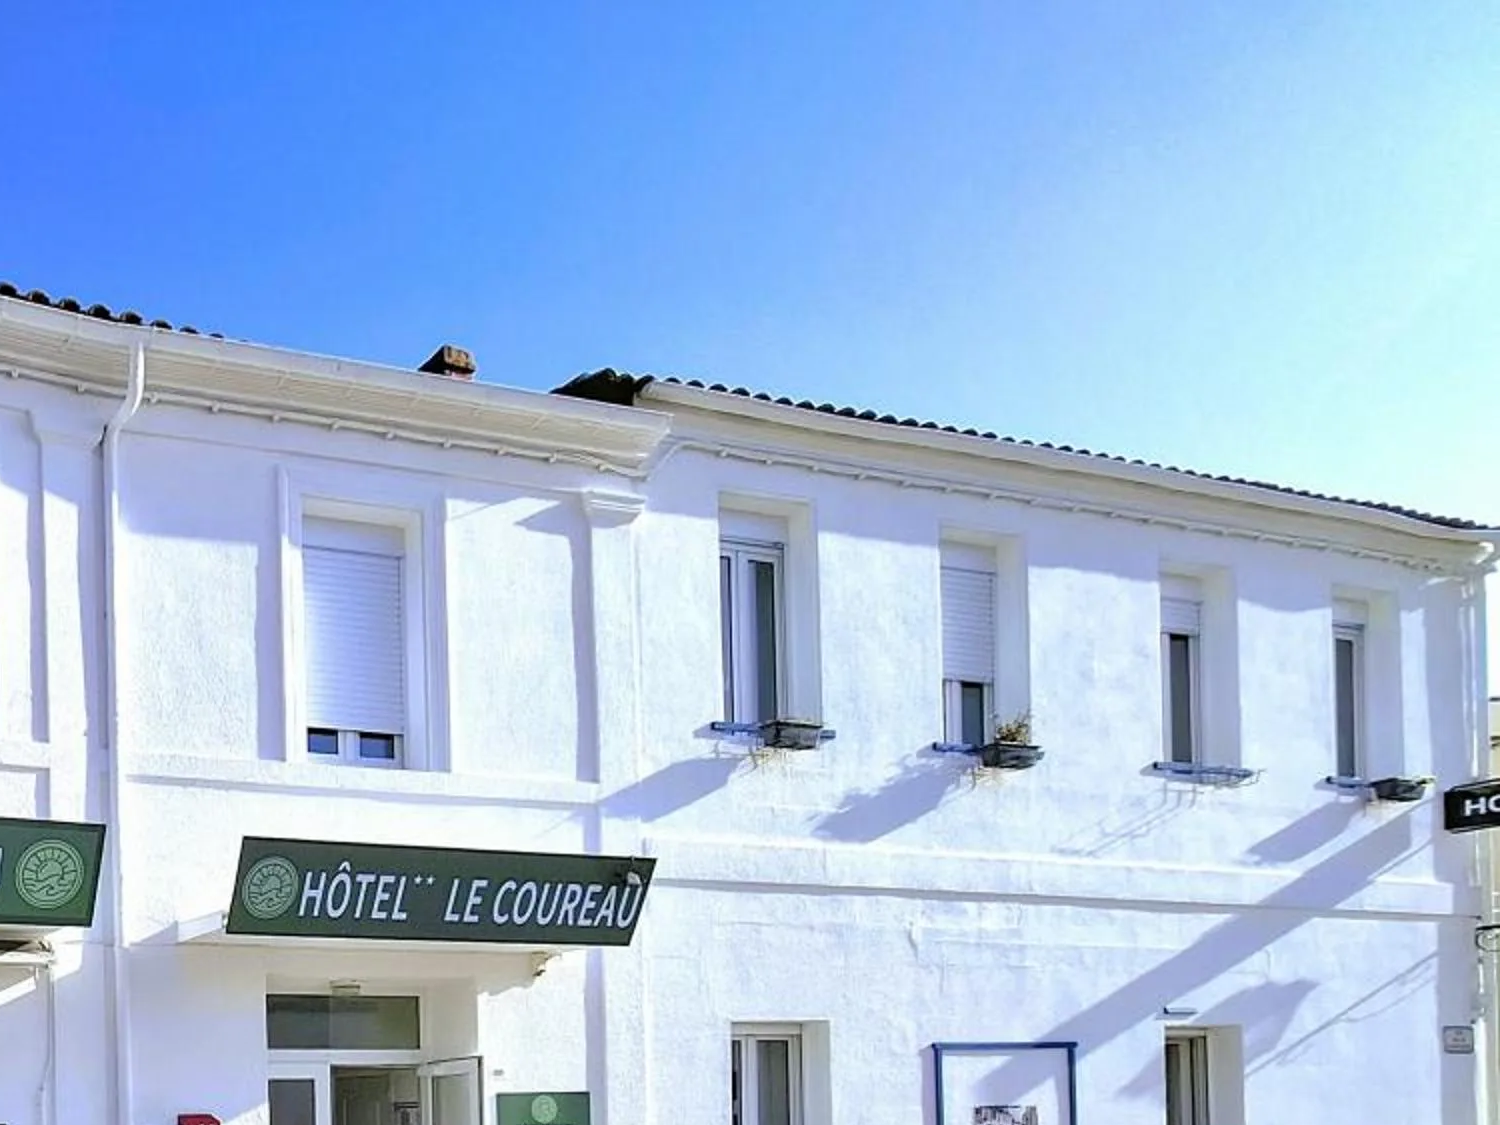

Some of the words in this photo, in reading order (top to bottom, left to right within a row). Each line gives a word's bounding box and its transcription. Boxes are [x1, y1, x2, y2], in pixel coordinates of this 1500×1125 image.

[299, 861, 408, 920] HÔTEL
[444, 878, 488, 923] LE
[493, 880, 642, 928] COUREAU
